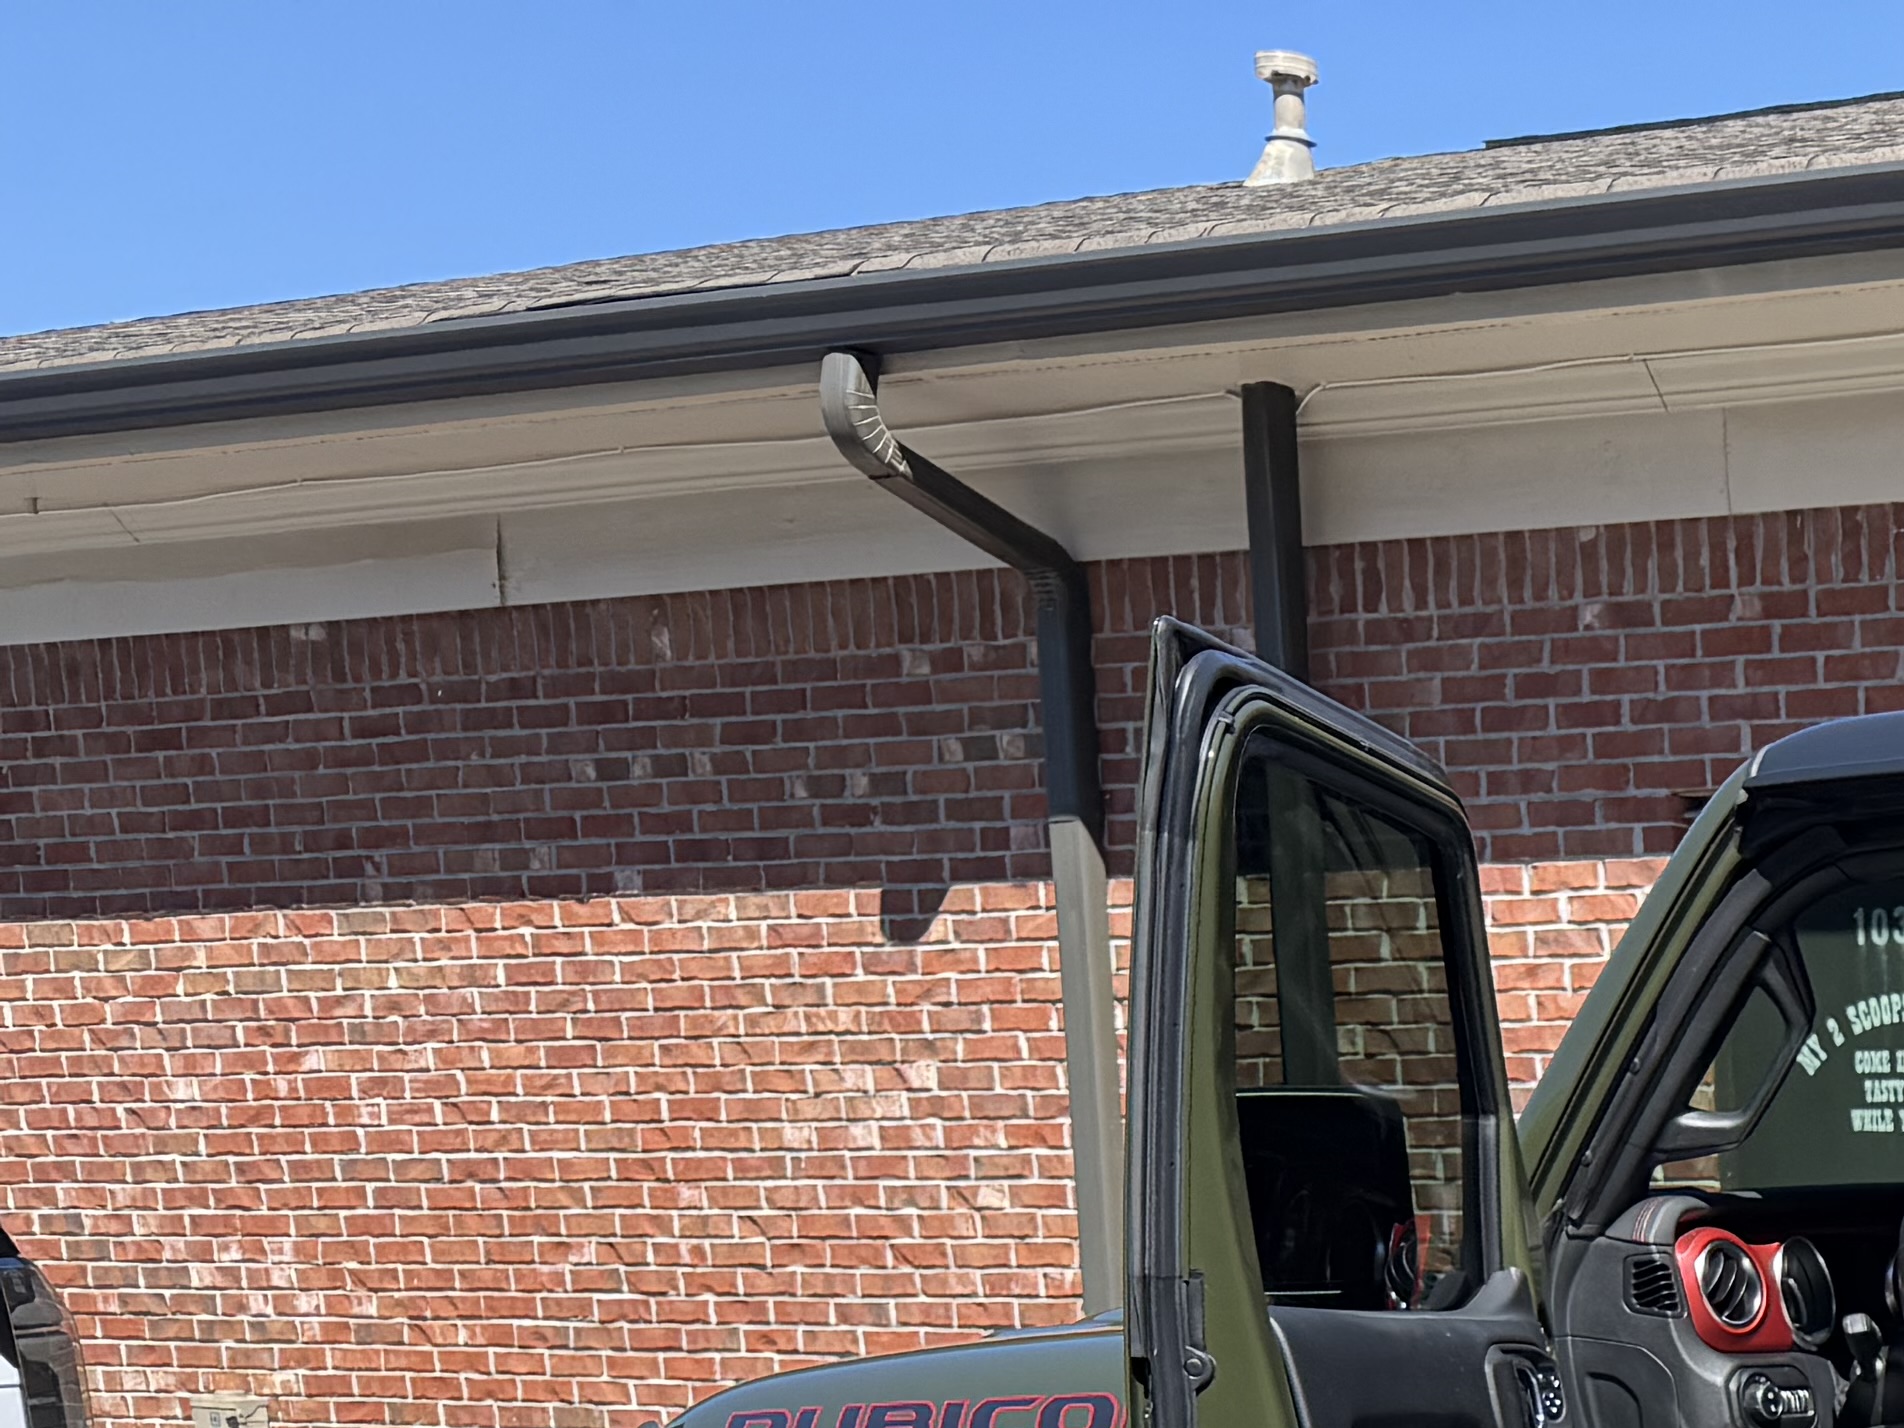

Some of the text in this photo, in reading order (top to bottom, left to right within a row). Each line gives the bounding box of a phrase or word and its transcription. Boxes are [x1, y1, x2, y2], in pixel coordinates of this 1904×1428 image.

[1796, 1033, 1828, 1077] MY
[1826, 1017, 1846, 1047] 2
[1854, 1049, 1892, 1074] COME
[1864, 1079, 1904, 1103] TASTY
[1851, 1108, 1894, 1132] WHILE
